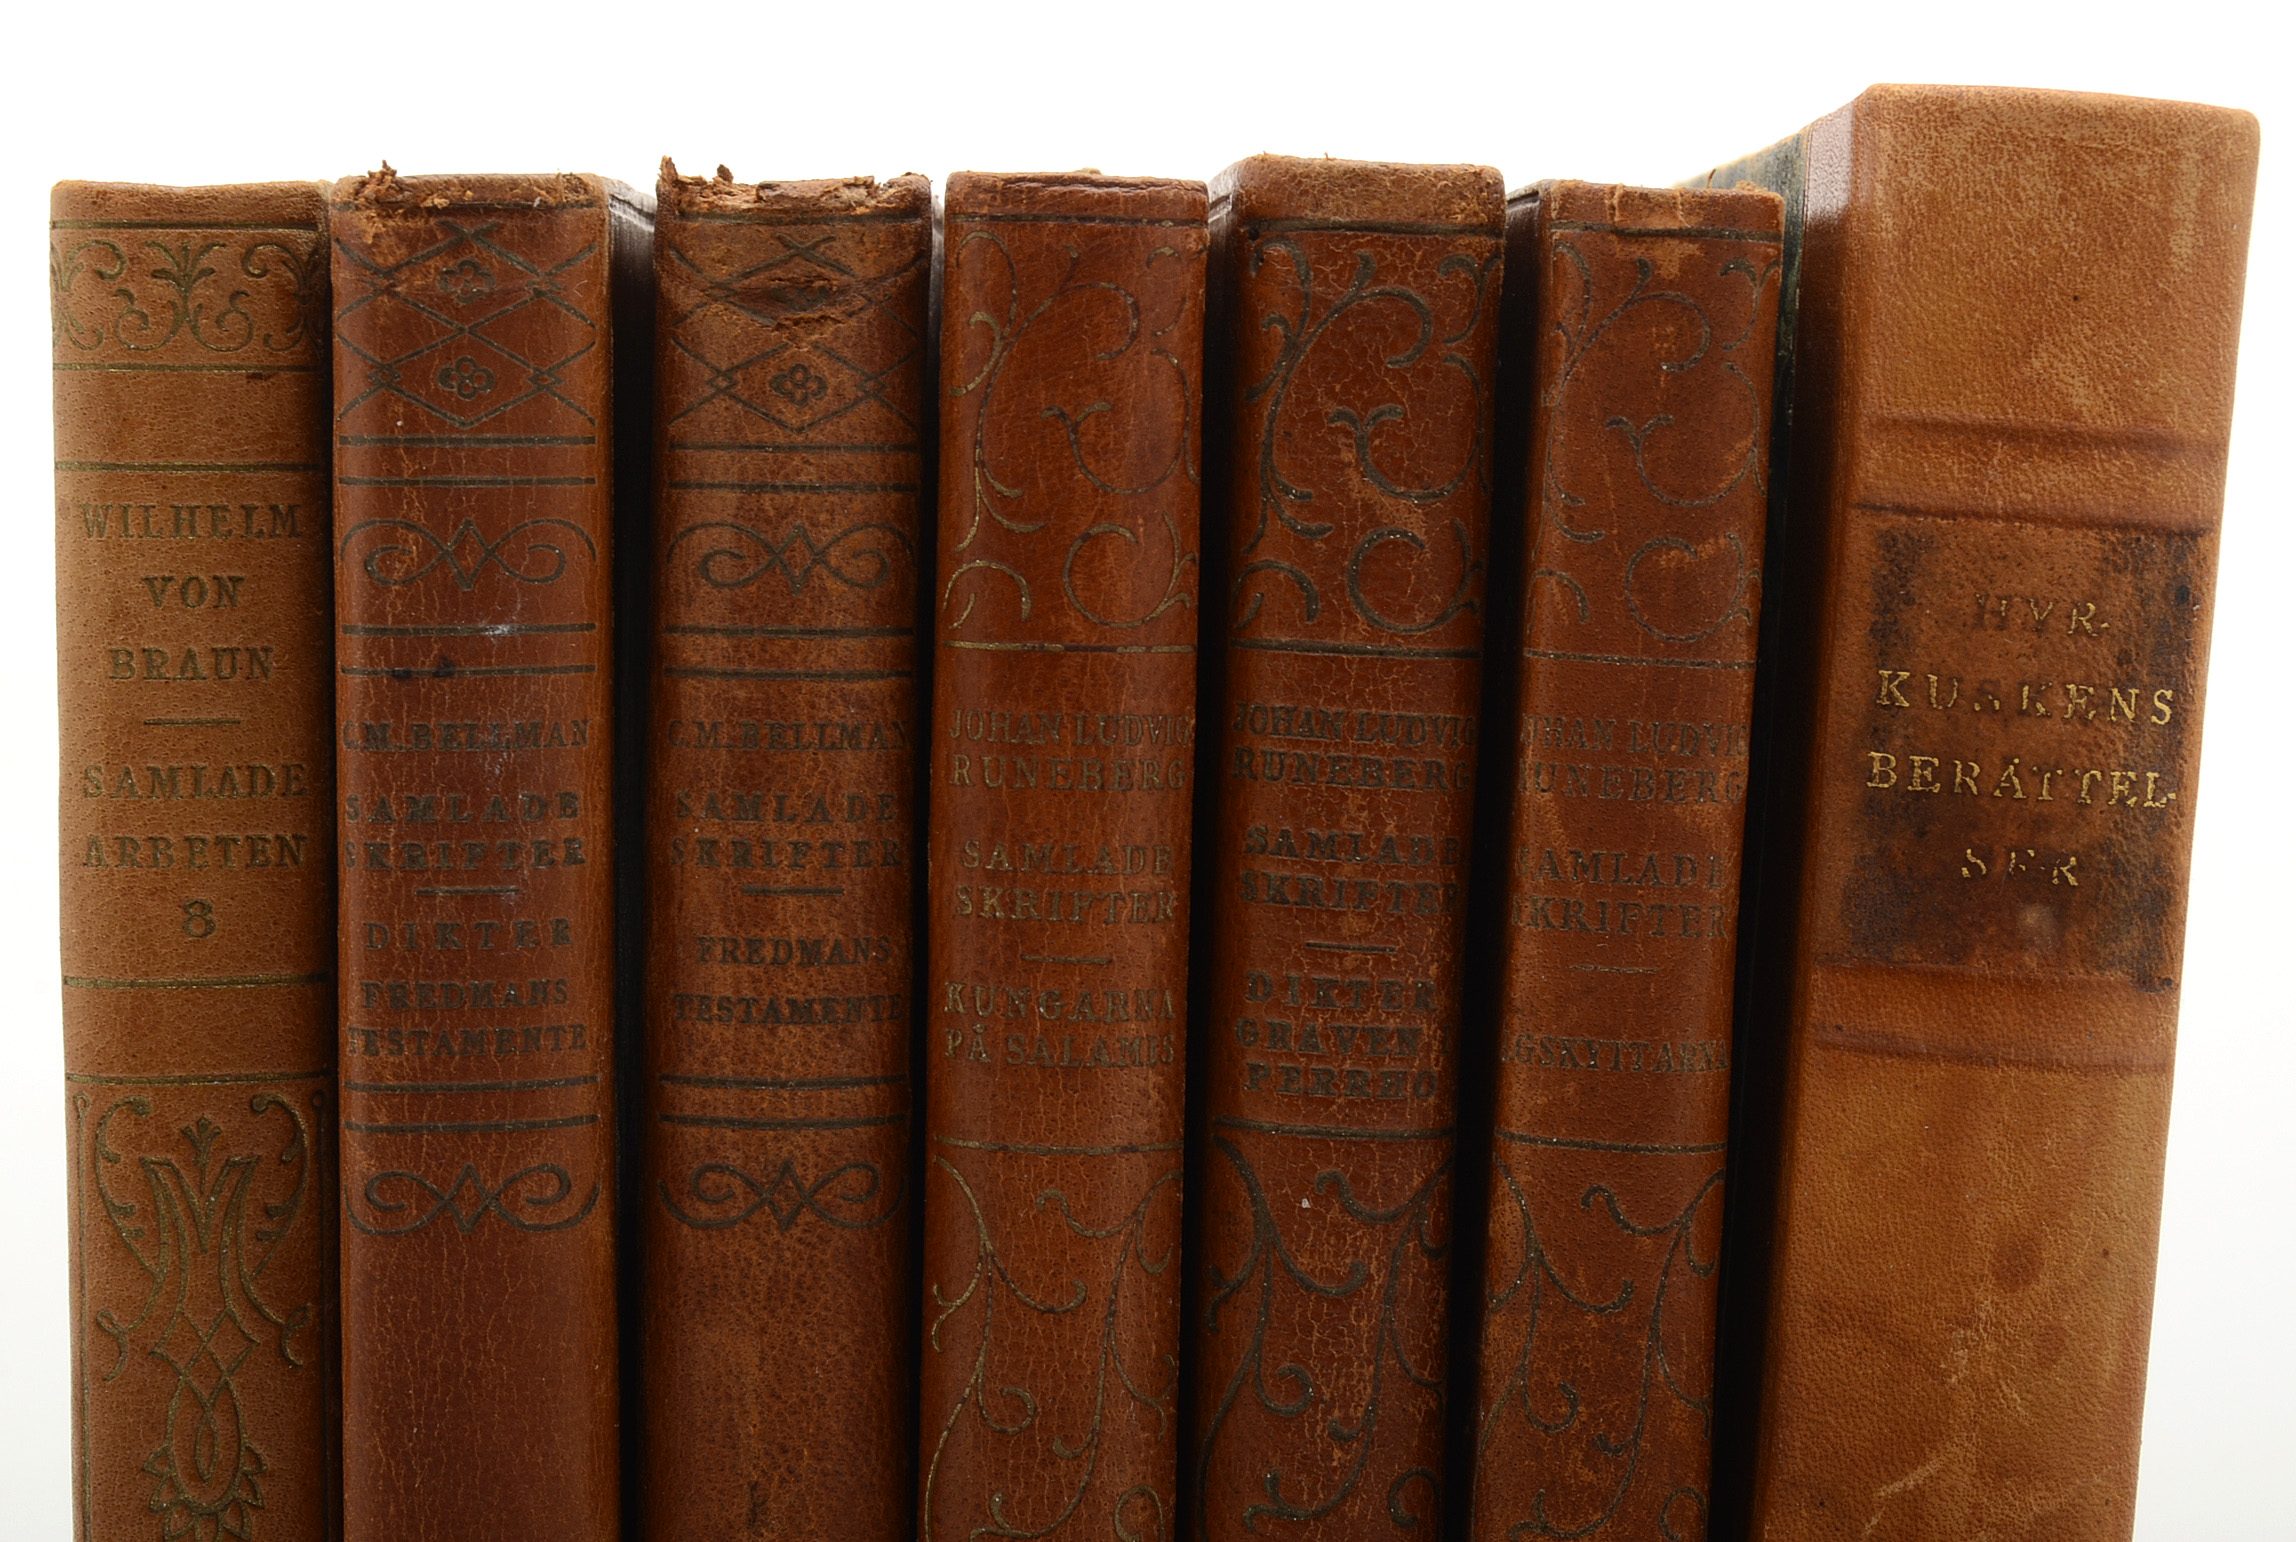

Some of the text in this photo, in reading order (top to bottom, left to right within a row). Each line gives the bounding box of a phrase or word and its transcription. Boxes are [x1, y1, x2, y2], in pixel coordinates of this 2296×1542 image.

[80, 503, 303, 538] WILHELM
[142, 576, 245, 609] VON
[109, 647, 274, 681] BRAUN
[949, 709, 1191, 747] JOHAN LUDVIG
[1233, 702, 1475, 747] JOHAN LUDVIG
[1627, 720, 1748, 757] LUDVIG
[83, 764, 307, 799] SAMLADE
[949, 754, 1186, 791] RUNEBERG
[1232, 746, 1470, 791] RUNEBERG
[346, 792, 580, 822] SAMLADE
[675, 790, 897, 823] SAMLADE
[83, 835, 307, 868] ARBETEN
[345, 838, 586, 870] SKRIFTER
[671, 837, 902, 870] SKRIFTER
[963, 840, 1172, 874] SAMLADE
[1245, 825, 1460, 866] SAMLADE
[1515, 846, 1726, 889] SAMLADE
[955, 885, 1175, 924] SKRIFTER
[1240, 870, 1460, 914] SKRIFTER
[182, 900, 216, 938] 8
[363, 918, 572, 950] DIKTER
[697, 935, 891, 967] FREDMANS
[361, 978, 568, 1010] FREDMANS
[673, 993, 904, 1025] TESTAMENTE
[944, 982, 1176, 1022] KUNGARNA
[1245, 971, 1438, 1012] DIKTER
[348, 1023, 587, 1056] TESTAMENTE
[945, 1024, 1175, 1067] PÅ SALAMIS
[1235, 1017, 1424, 1057] GRAVEN
[1244, 1062, 1438, 1099] PERRHO
